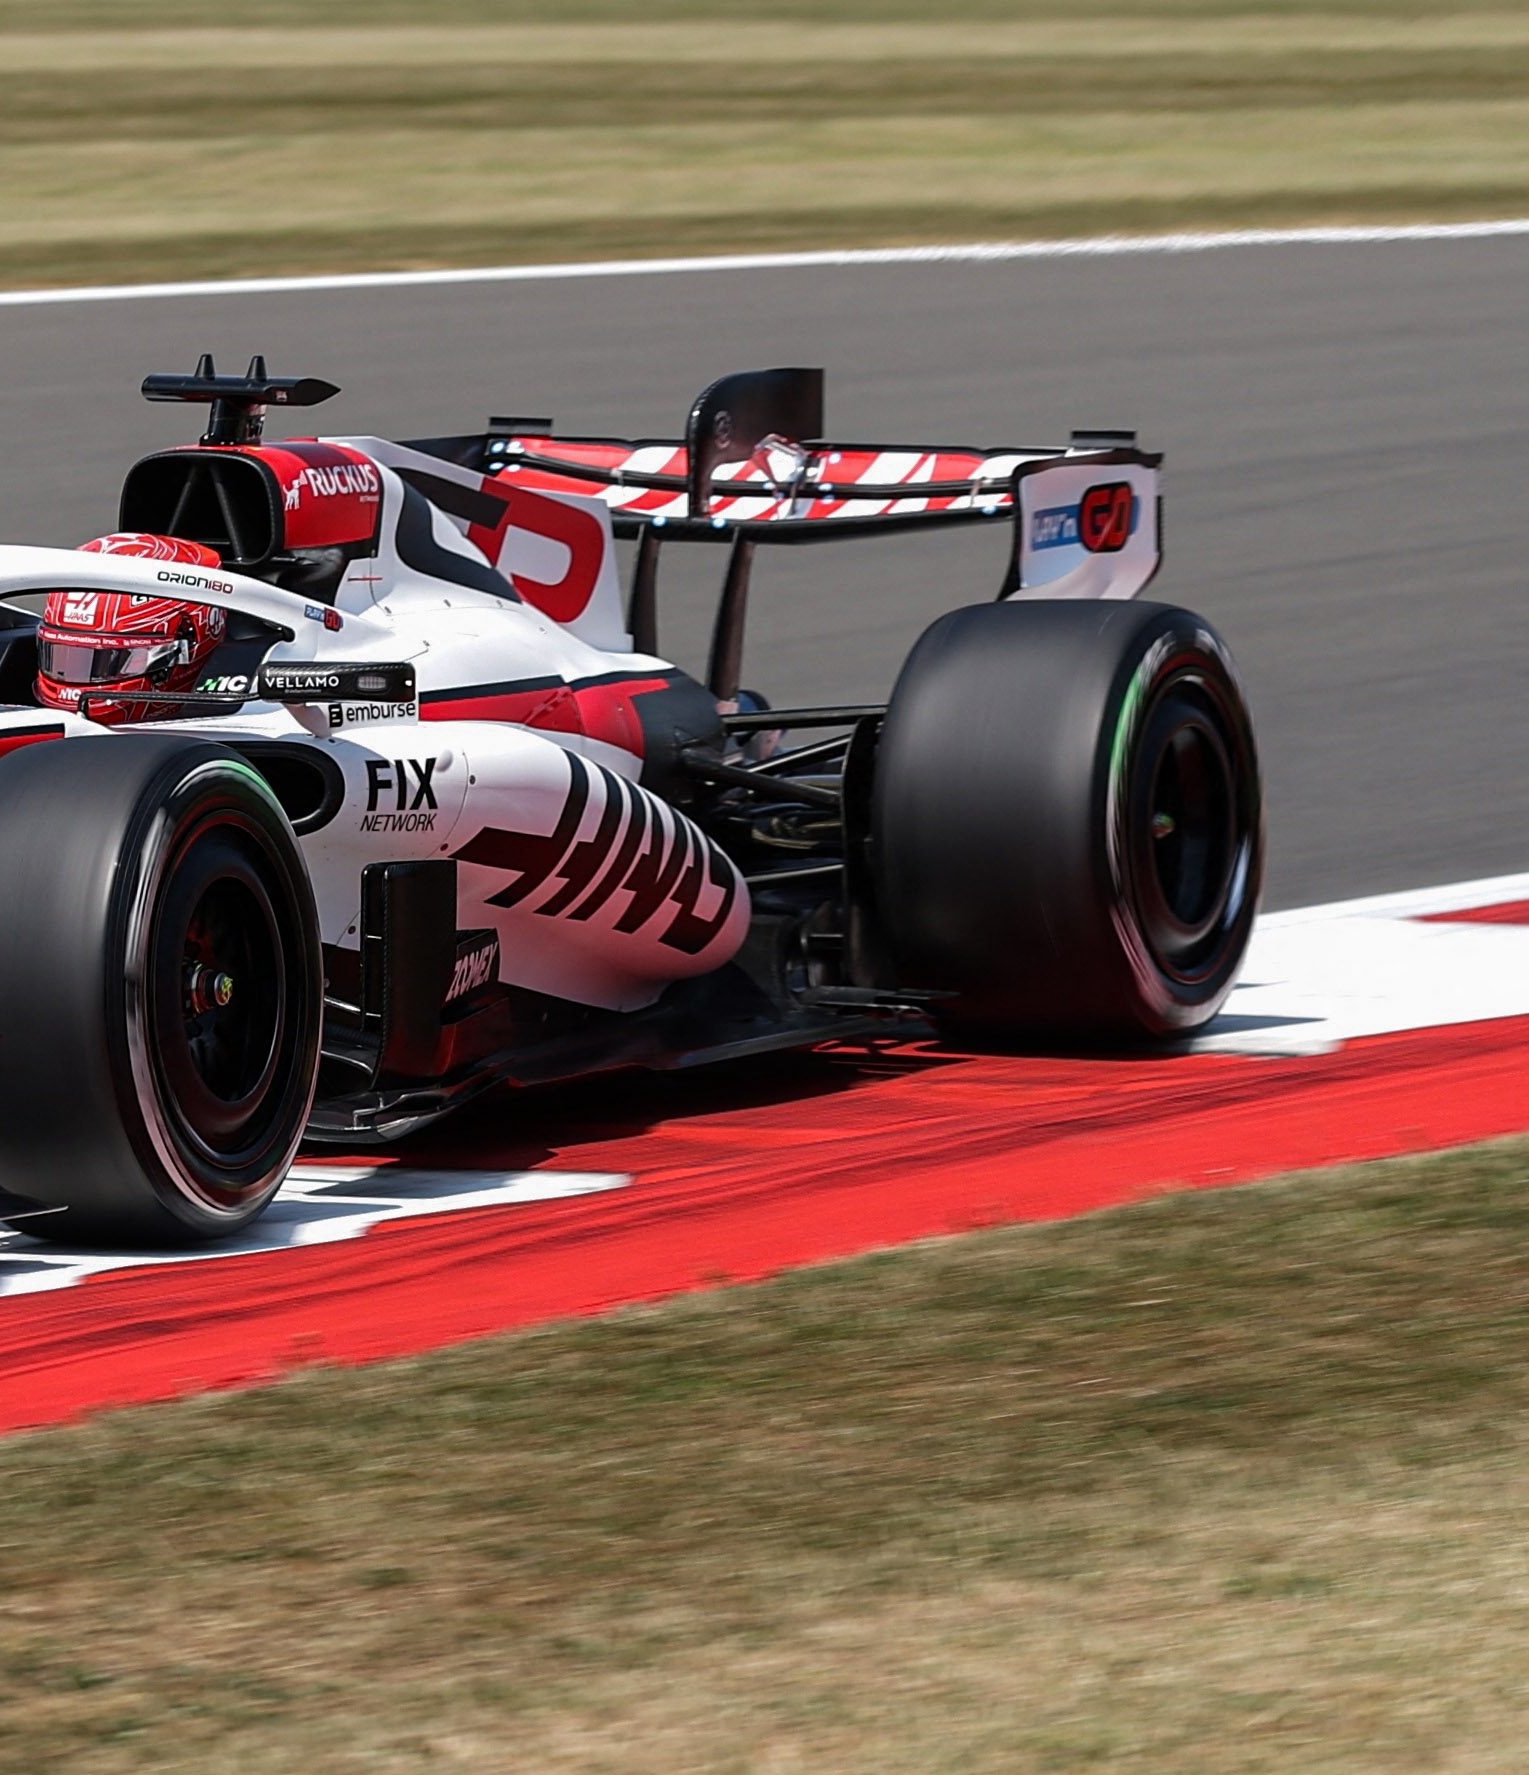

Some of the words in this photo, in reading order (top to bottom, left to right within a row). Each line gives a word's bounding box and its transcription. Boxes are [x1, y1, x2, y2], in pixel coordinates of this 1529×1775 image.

[305, 463, 379, 497] RUCKUS
[1082, 484, 1133, 550] GO
[157, 570, 234, 594] ORION180
[57, 633, 100, 645] Automation
[102, 638, 119, 646] Inc.
[264, 676, 340, 688] VELLAMO
[346, 702, 416, 722] emburse
[365, 757, 439, 812] FIX
[359, 813, 437, 832] NETWORK
